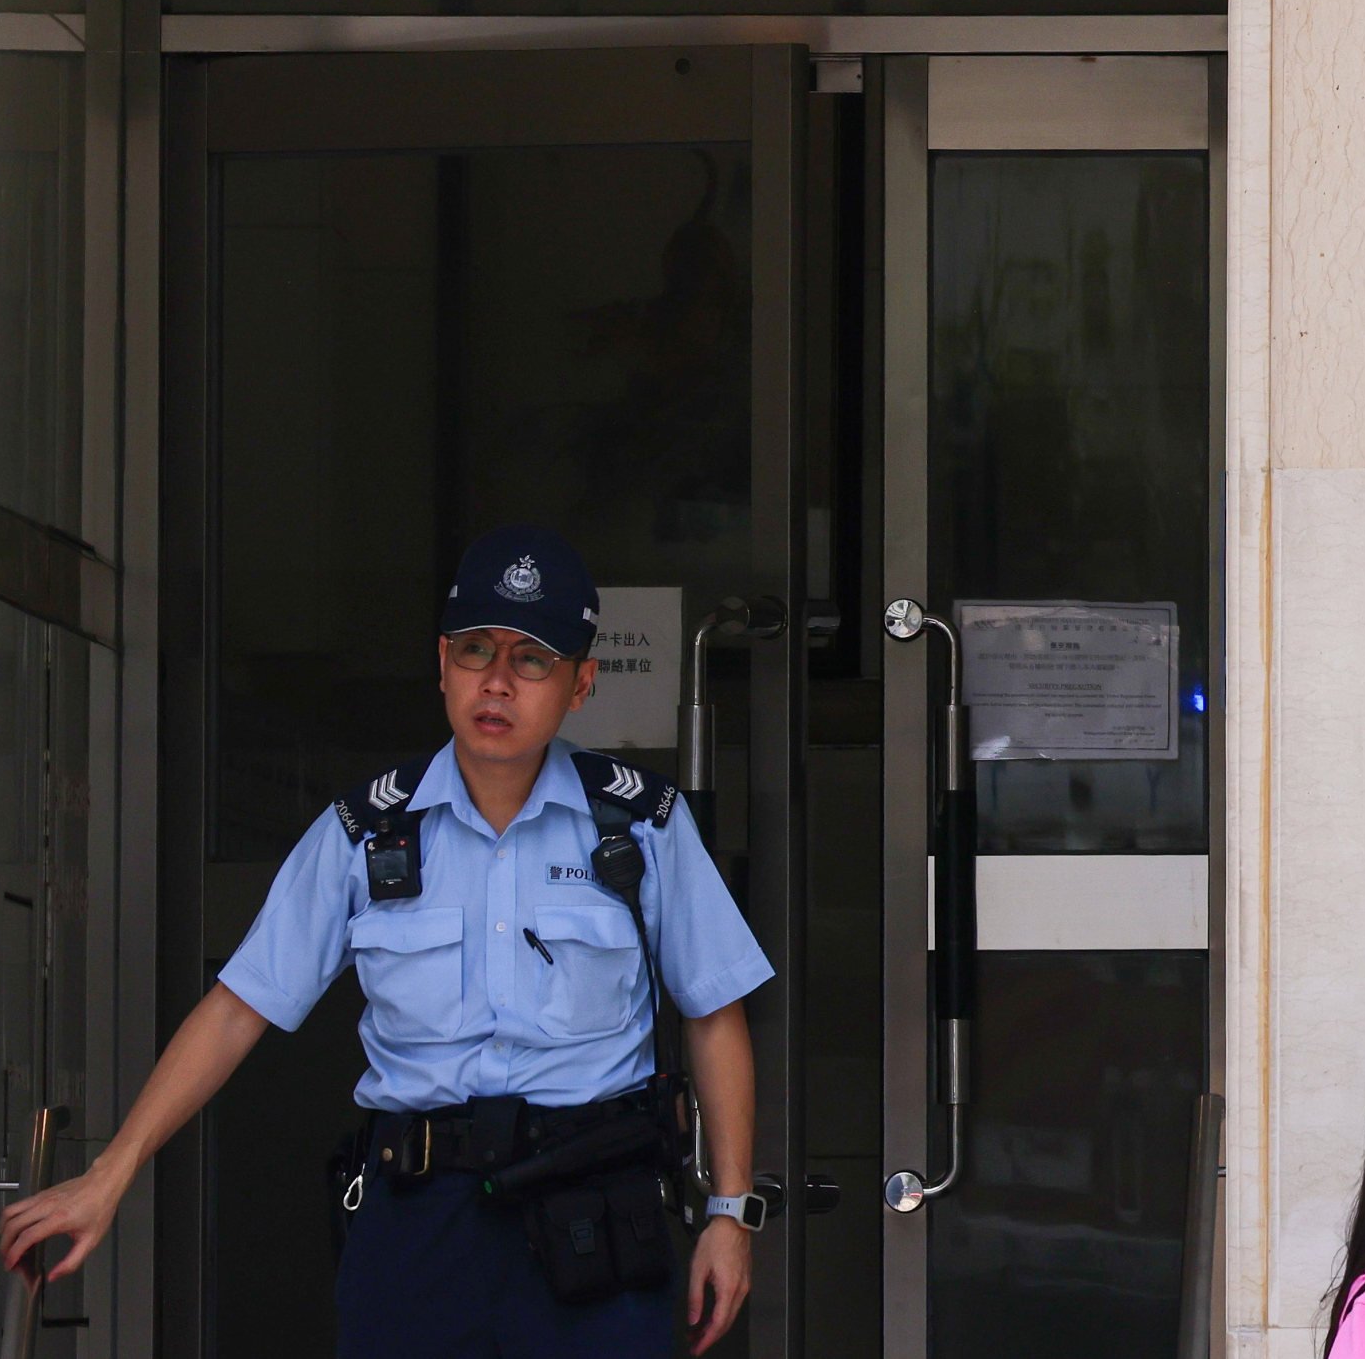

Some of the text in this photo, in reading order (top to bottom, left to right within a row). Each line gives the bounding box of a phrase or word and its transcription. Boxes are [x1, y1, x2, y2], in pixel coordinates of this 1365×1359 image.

[590, 631, 651, 648] 戶卡出入
[656, 784, 675, 819] 20646
[335, 800, 360, 834] 20646
[565, 867, 598, 884] POLI
